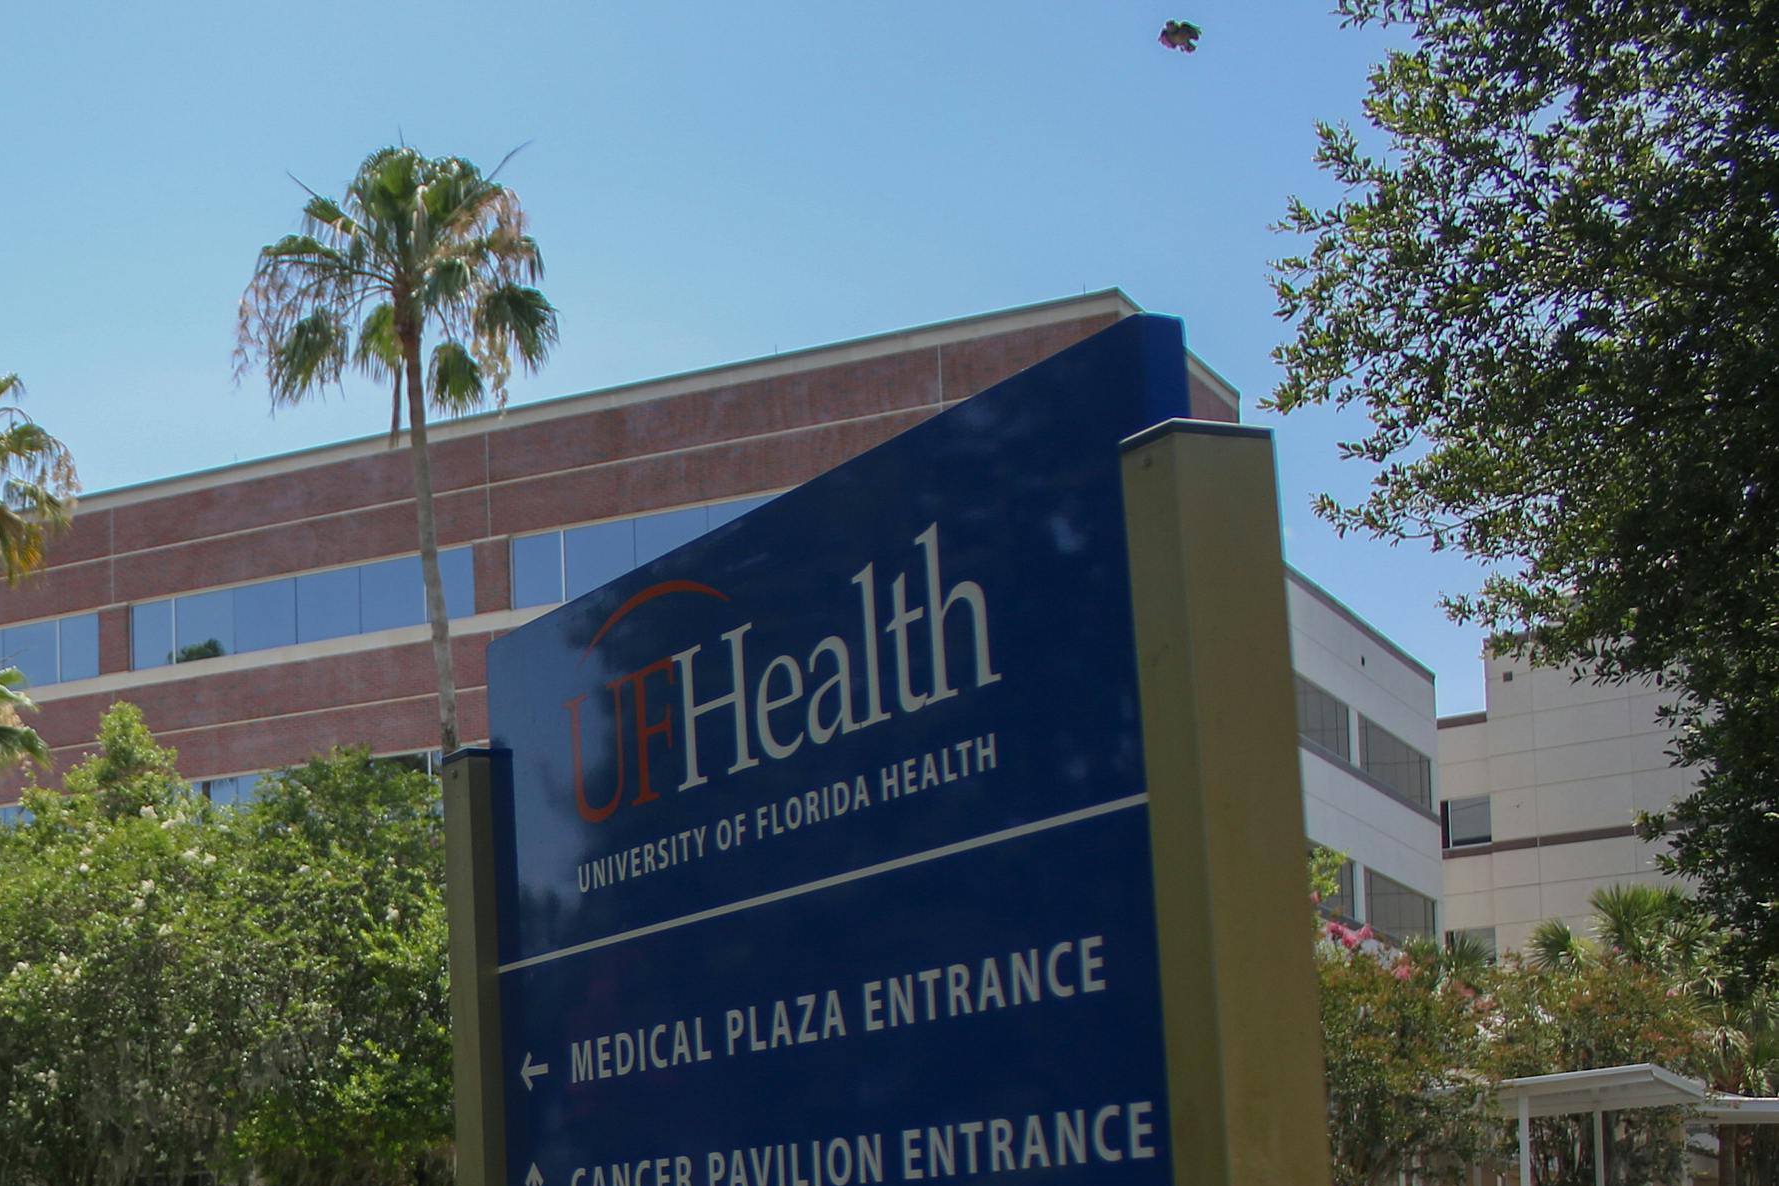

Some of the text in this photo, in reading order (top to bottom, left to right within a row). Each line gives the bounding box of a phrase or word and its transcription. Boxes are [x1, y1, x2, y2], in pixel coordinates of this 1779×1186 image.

[578, 733, 997, 893] UNIVERSITY OF FLORIDA HEALTH
[571, 935, 1106, 1083] MEDICAL PLAZA ENTRANCE
[903, 1101, 1155, 1181] ENTRANCE
